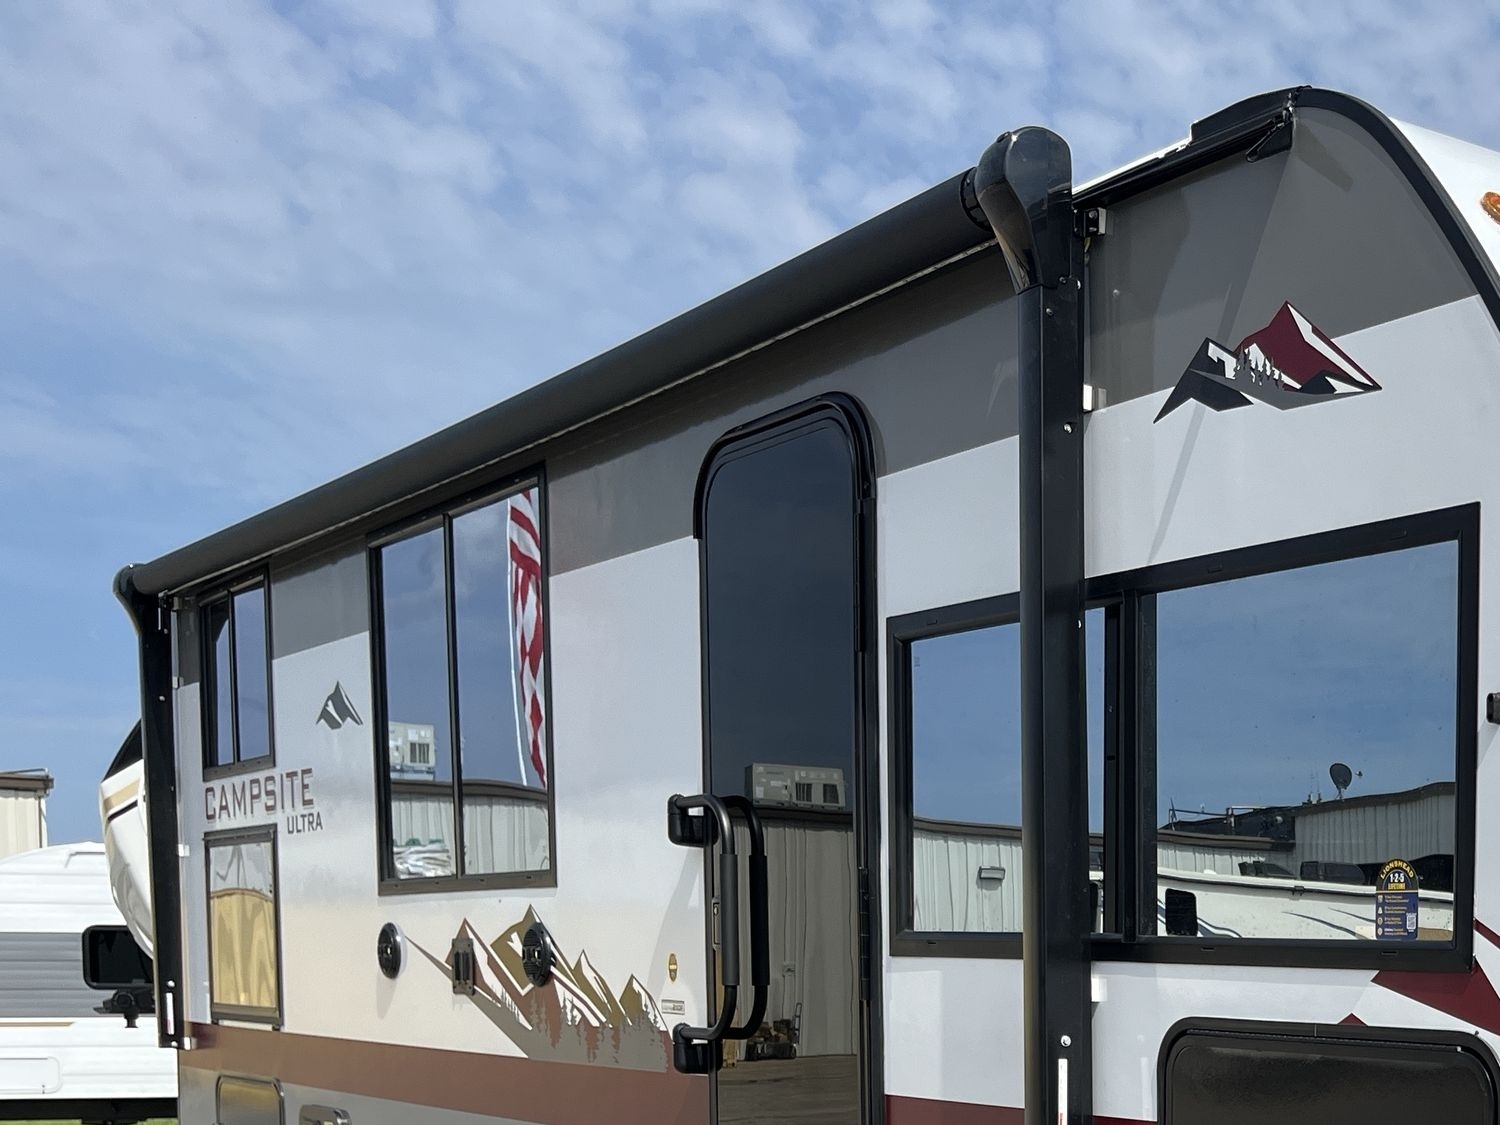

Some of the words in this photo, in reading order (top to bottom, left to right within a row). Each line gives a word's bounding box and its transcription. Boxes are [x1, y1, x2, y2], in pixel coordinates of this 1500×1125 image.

[204, 768, 314, 822] CAMPSITE
[286, 811, 323, 834] ULTRA
[1380, 860, 1414, 879] LIONSHEAD
